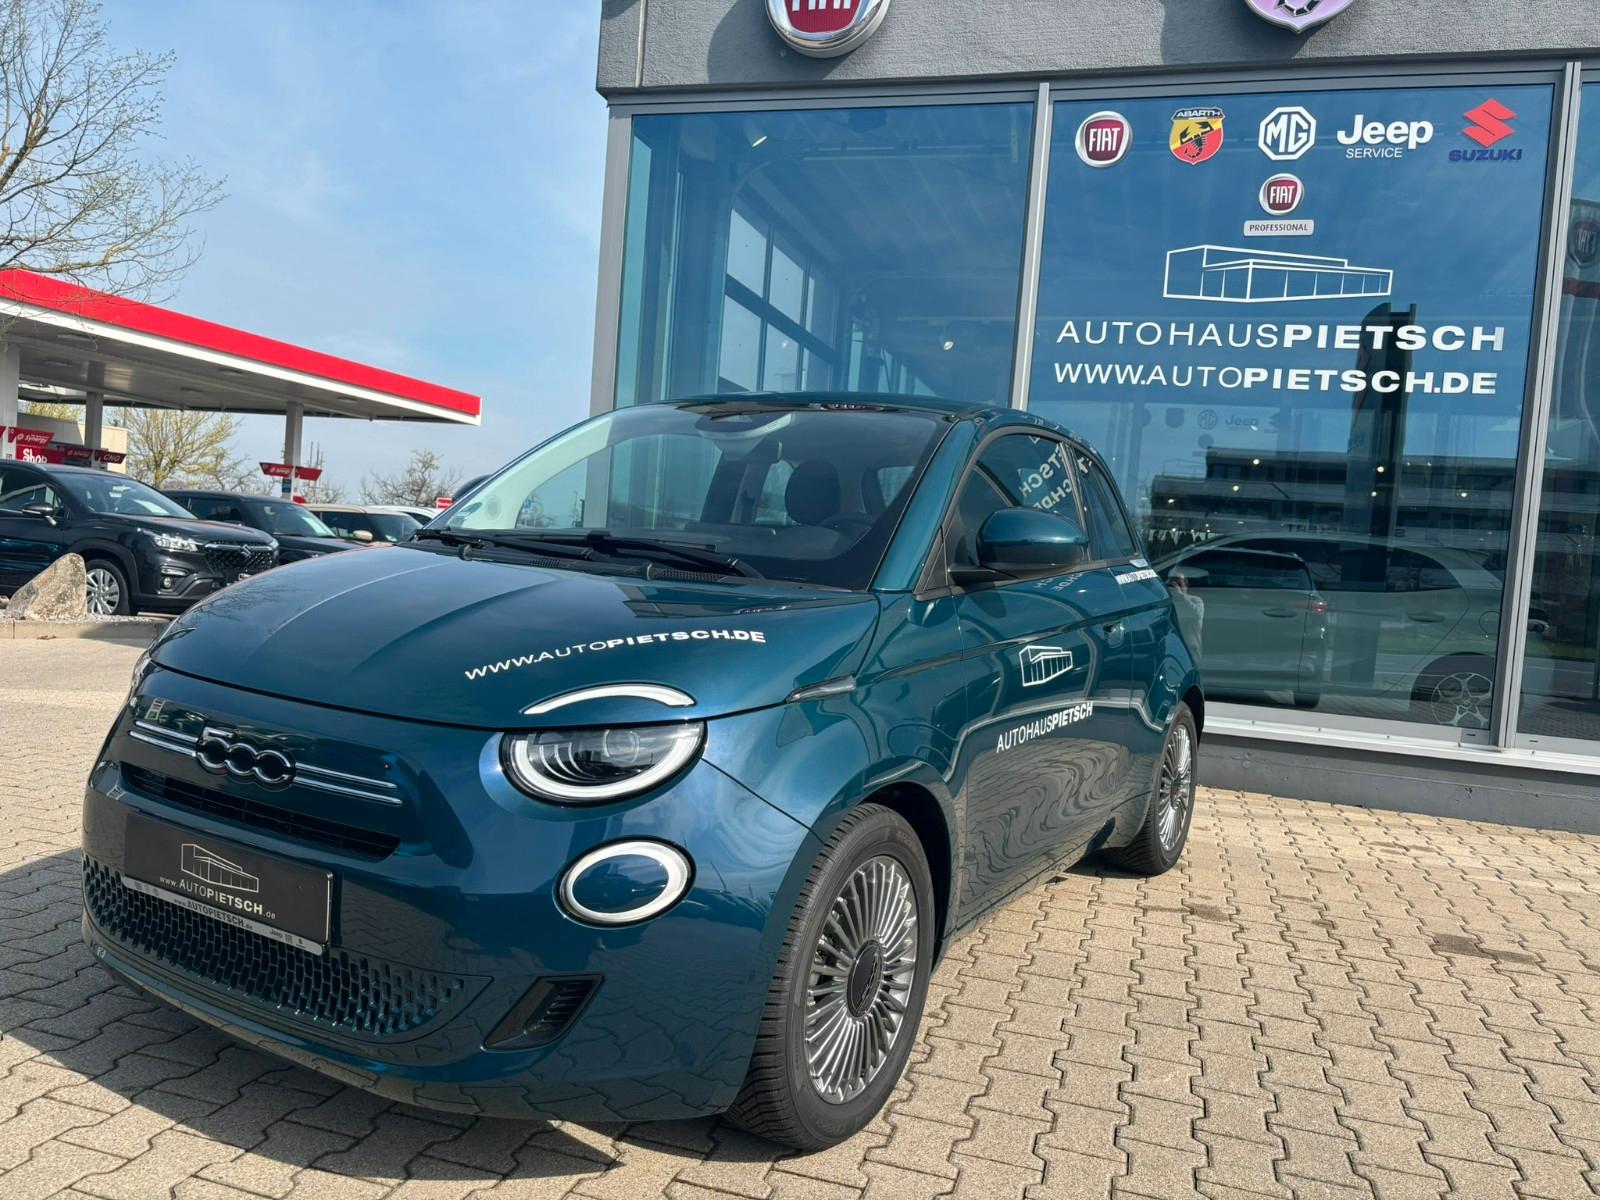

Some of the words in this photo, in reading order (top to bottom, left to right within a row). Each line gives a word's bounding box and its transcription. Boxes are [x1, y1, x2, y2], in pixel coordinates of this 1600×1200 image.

[1176, 108, 1222, 118] ABARTH
[1088, 127, 1121, 152] FIAT
[1265, 113, 1309, 153] MG
[1336, 113, 1434, 150] Jeep
[1345, 147, 1403, 159] SERVICE
[1448, 148, 1523, 162] SUZUKI
[1269, 185, 1295, 204] FIAT
[1249, 222, 1308, 233] PROFESSIONAL
[1056, 320, 1505, 351] AUTOHAUSPIETSCH
[1054, 362, 1498, 395] WWW.AUTOPIETSCH.DE
[103, 454, 121, 462] CNG
[464, 629, 766, 680] WWW.AUTOPIETSCH.DE
[996, 701, 1094, 754] AUTOHAUSPIETSCH
[197, 726, 291, 784] 500
[159, 876, 276, 920] www.AUTOPIETSCH.de
